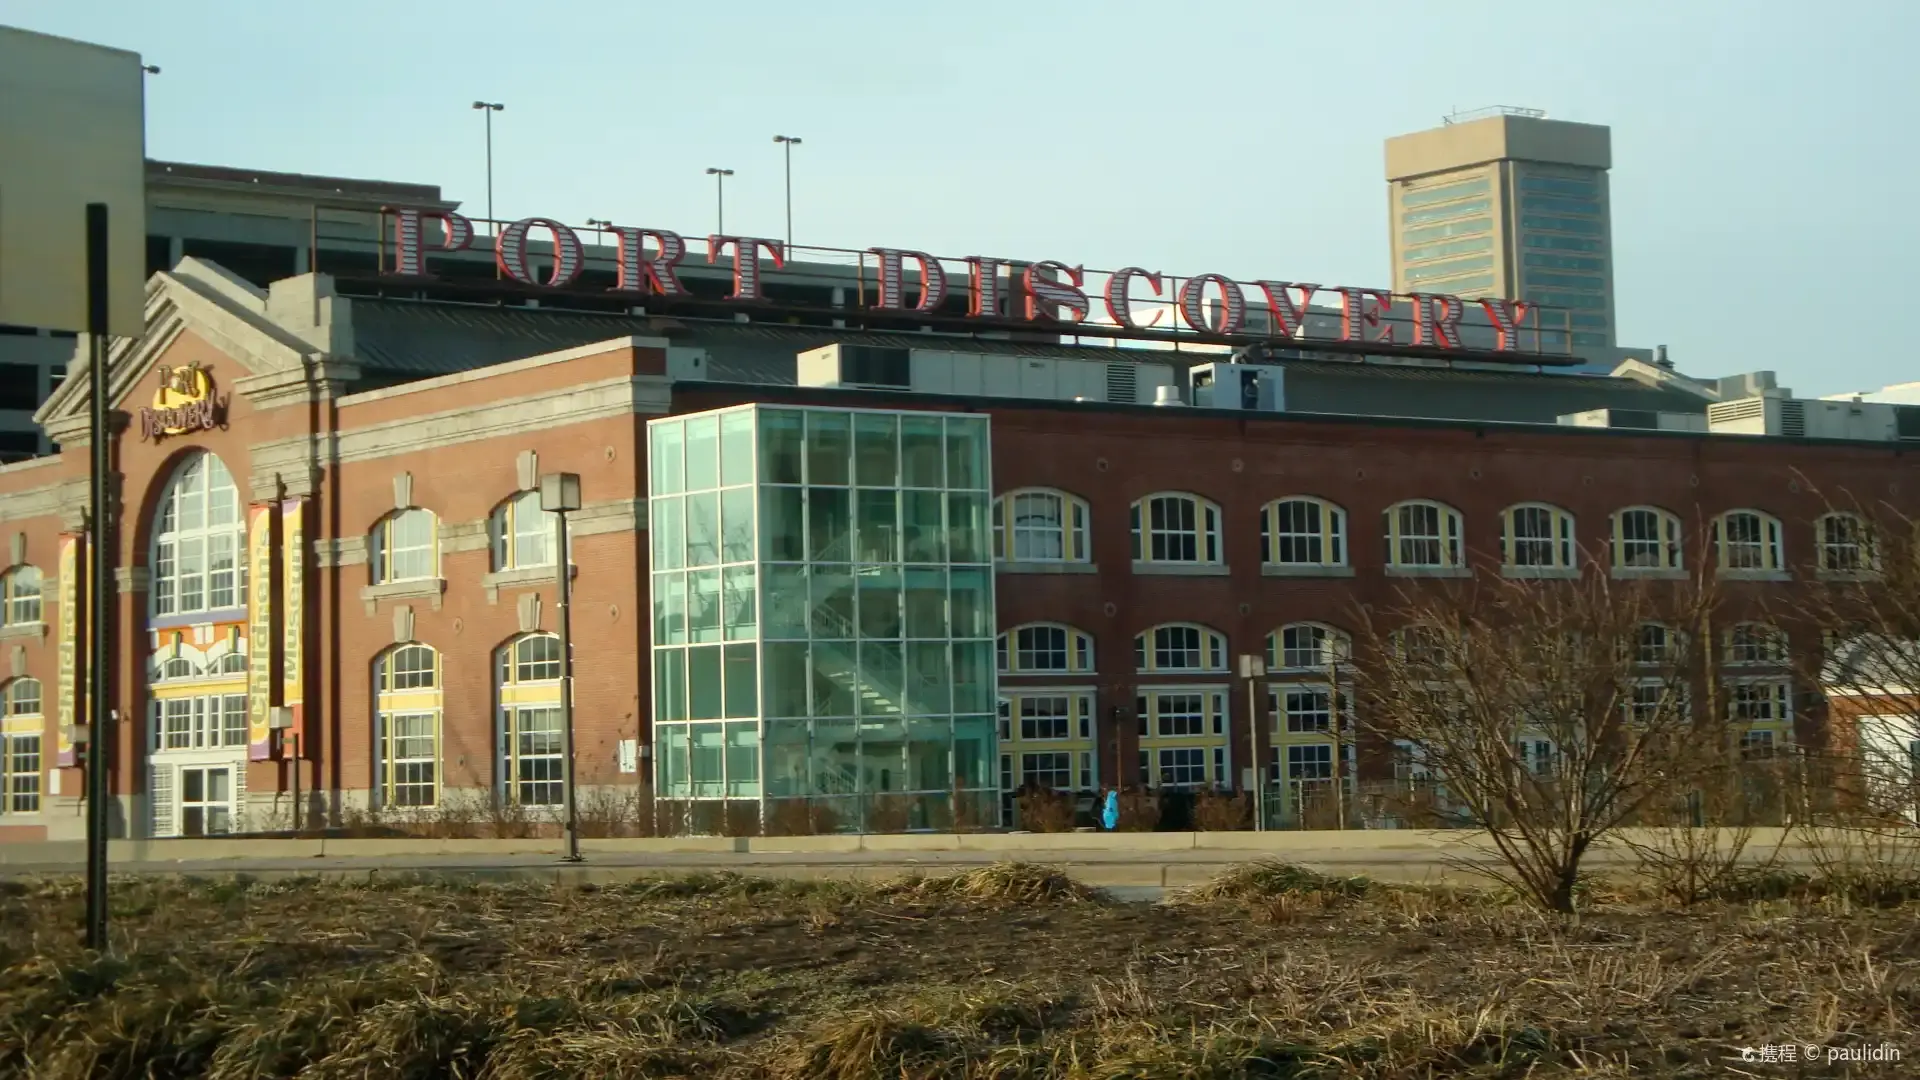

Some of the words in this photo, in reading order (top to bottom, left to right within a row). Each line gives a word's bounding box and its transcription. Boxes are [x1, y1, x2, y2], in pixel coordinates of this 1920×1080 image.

[380, 206, 784, 302] PORT
[867, 247, 1529, 353] DISCOVERY
[251, 527, 270, 725] Children's
[284, 529, 304, 681] Museum
